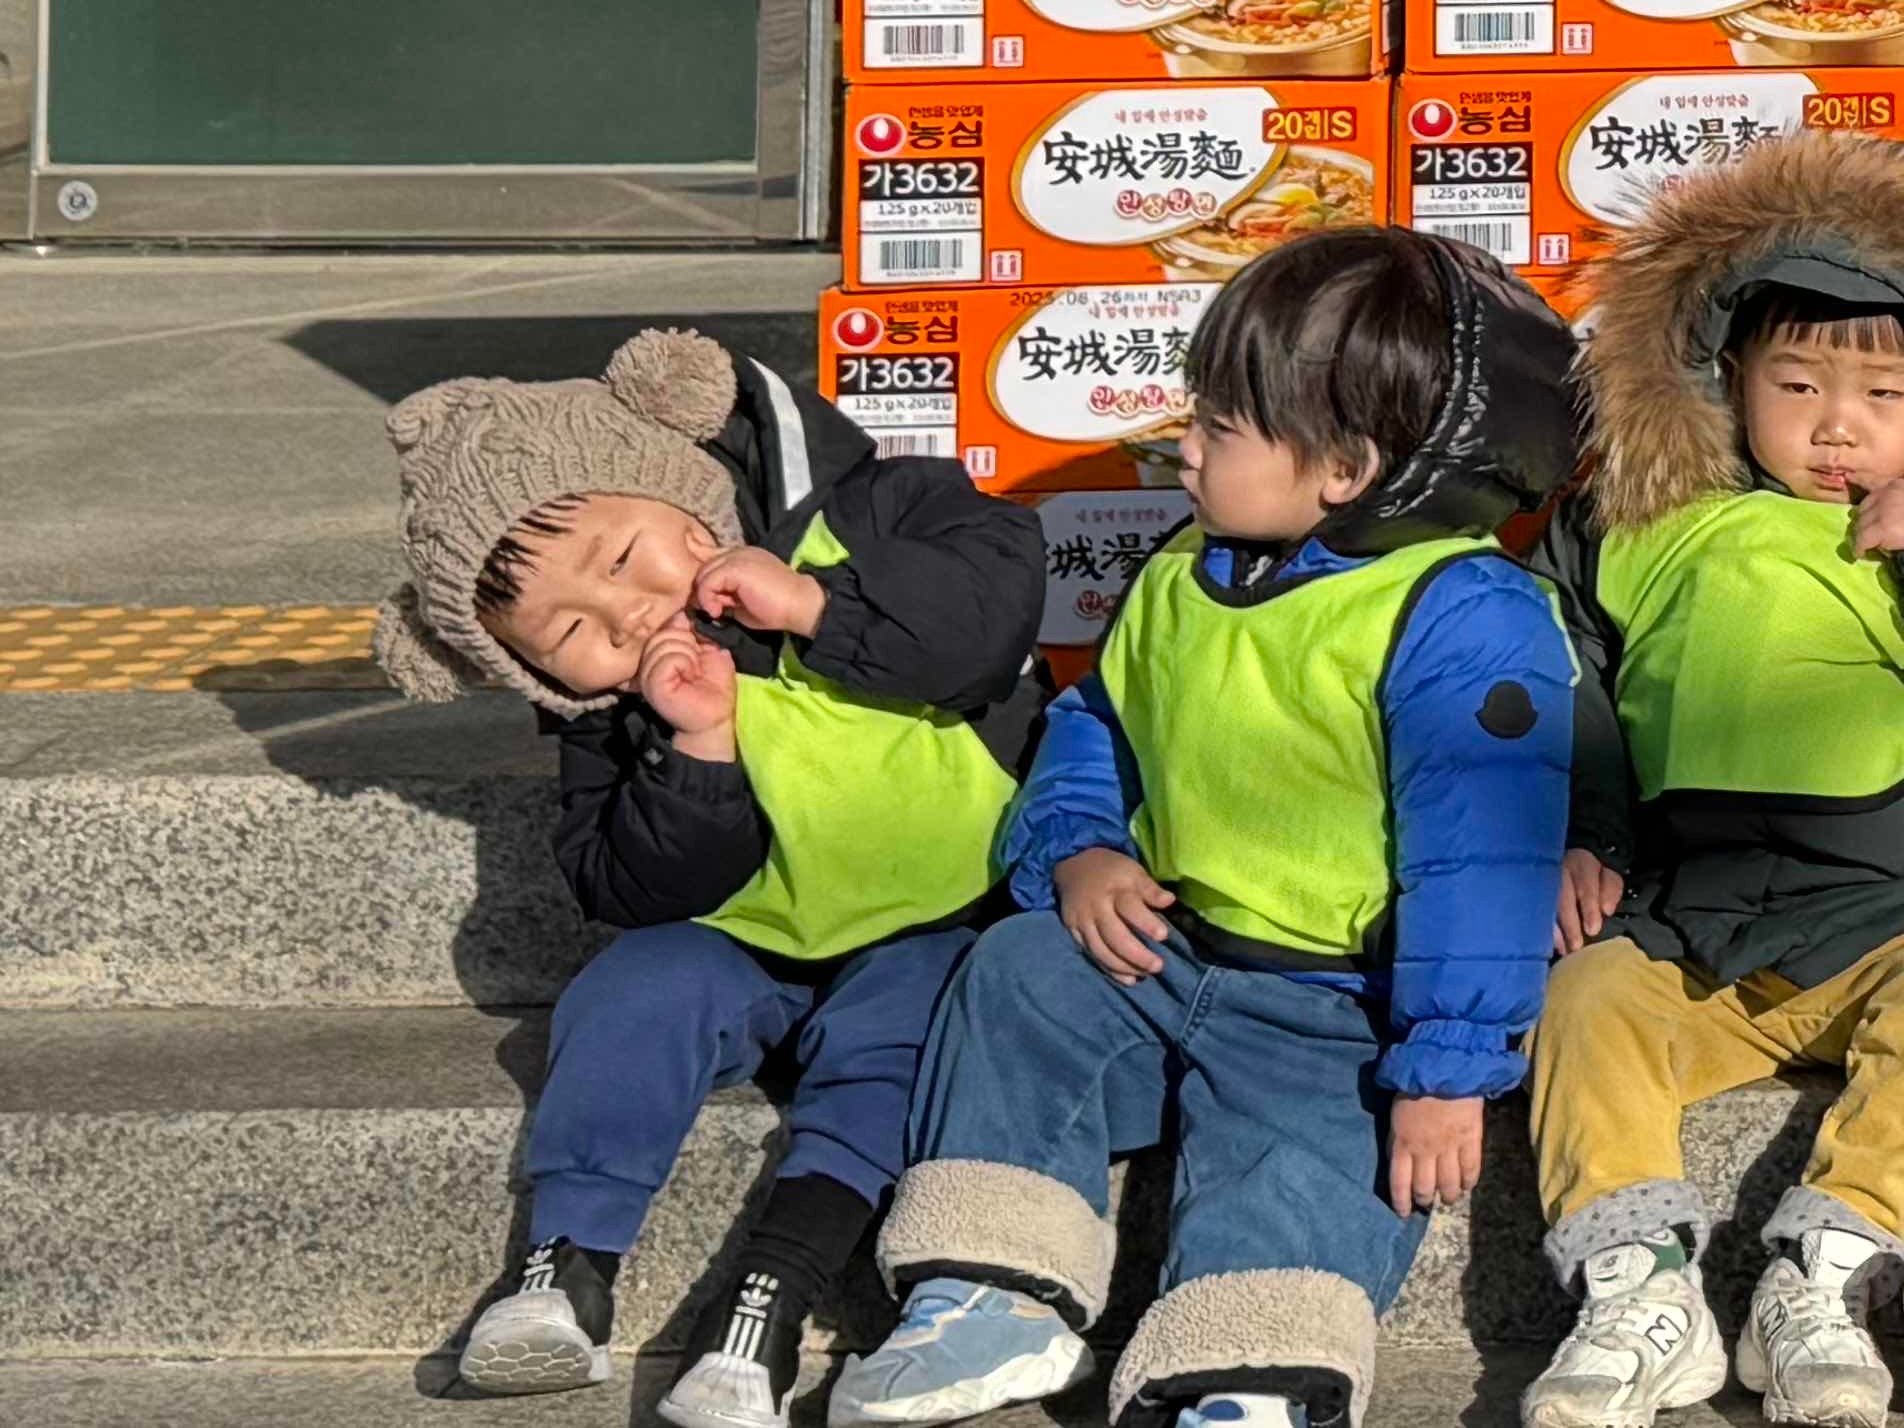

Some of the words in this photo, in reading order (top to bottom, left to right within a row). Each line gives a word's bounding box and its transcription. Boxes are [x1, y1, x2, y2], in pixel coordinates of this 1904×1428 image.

[908, 121, 983, 148] 농심
[1458, 106, 1532, 133] 농심
[1044, 131, 1246, 185] 安城湯麵
[1415, 147, 1527, 178] 가3632
[863, 163, 979, 194] 가3632
[884, 317, 959, 343] 농심
[839, 358, 955, 390] 가3632
